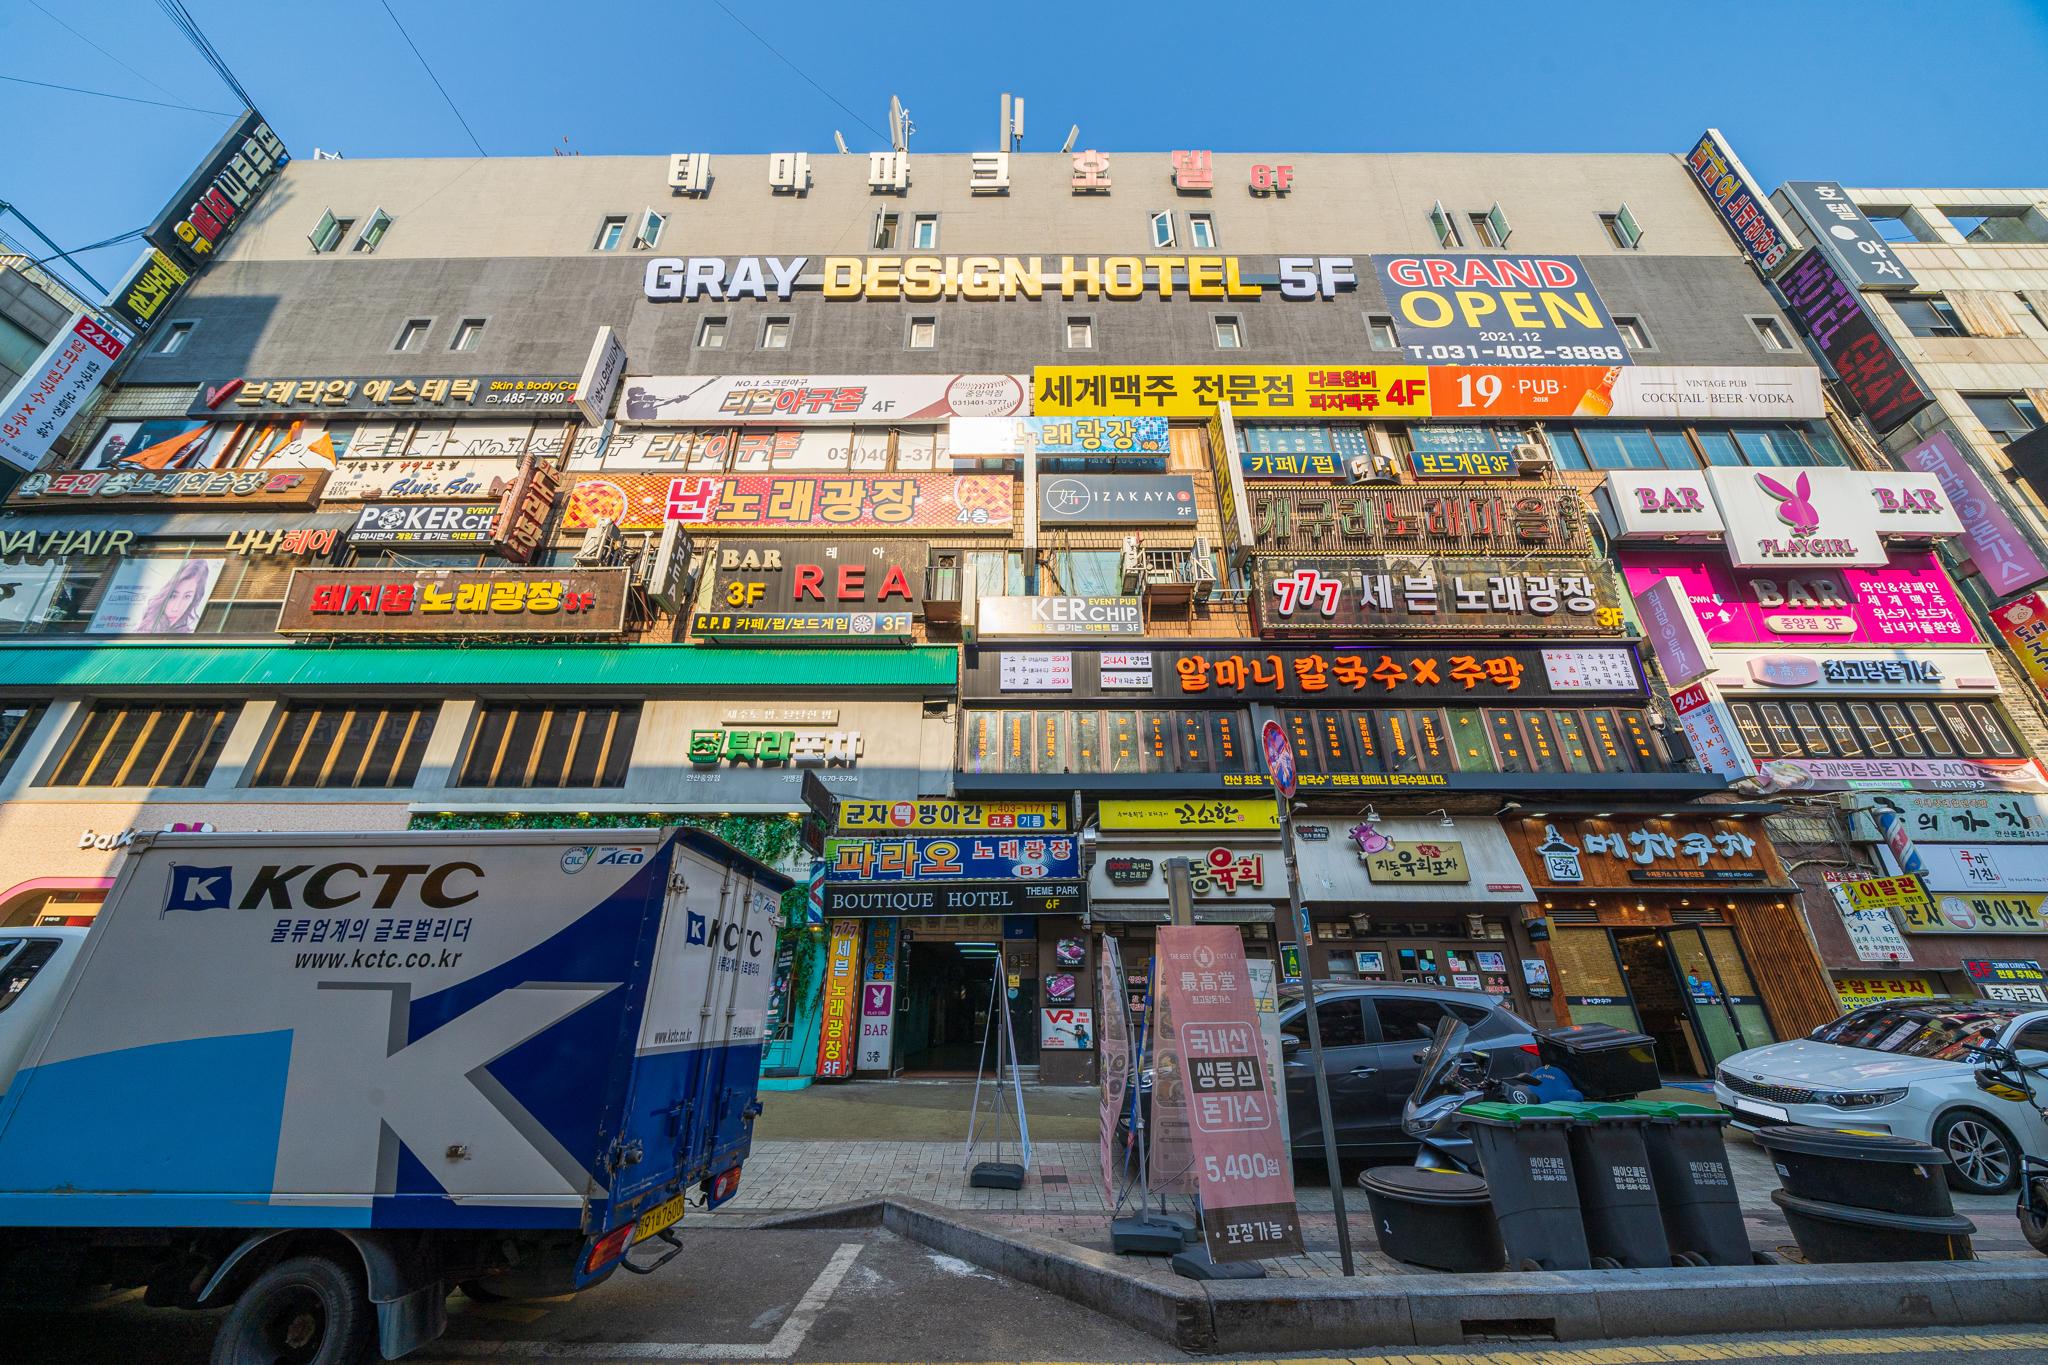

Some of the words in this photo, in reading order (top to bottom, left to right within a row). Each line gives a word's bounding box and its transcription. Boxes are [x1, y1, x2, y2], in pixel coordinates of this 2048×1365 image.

[1249, 163, 1296, 192] 6F
[1814, 186, 1860, 221] 호텔
[174, 220, 213, 256] 6F
[1765, 245, 1785, 267] B1
[1858, 241, 1903, 279] 야자
[644, 257, 809, 299] GRAY
[823, 256, 1043, 298] DESIGN
[1062, 256, 1263, 297] HOTEL
[1279, 256, 1357, 299] 5F
[1387, 258, 1578, 288] GRAND
[1400, 291, 1604, 329] OPEN
[135, 316, 150, 328] 3F
[81, 323, 118, 355] 24시
[1478, 332, 1542, 342] 2021.12
[1408, 345, 1624, 360] T.031-402-3888
[490, 381, 514, 390] Skin
[516, 382, 526, 390] &
[527, 382, 557, 392] Body
[735, 379, 761, 388] NO.1
[761, 378, 809, 388] 스크린야구
[1309, 370, 1377, 388] 다트완비
[234, 379, 357, 407] 브레라인
[363, 379, 482, 407] 에스테틱
[718, 386, 868, 416] 리얼야구존
[871, 400, 896, 413] 4F
[1040, 375, 1177, 407] 세계맥주
[1192, 375, 1295, 406] 전문점
[1386, 379, 1426, 406] 4F
[1456, 373, 1502, 409] 19
[1518, 380, 1560, 394] PUB
[1641, 392, 1704, 405] COCKTAIL
[1710, 393, 1744, 404] BEER
[1749, 393, 1795, 405] VODKA
[1309, 394, 1380, 411] 피자맥주
[1251, 456, 1335, 474] 카페/펍
[1491, 457, 1509, 473] 3F
[387, 477, 440, 497] Blues
[443, 477, 483, 496] Bar
[1093, 491, 1176, 502] IZAKAYA
[466, 507, 497, 515] EVENT
[1635, 487, 1705, 514] BAR
[1871, 487, 1944, 514] BAR
[955, 507, 990, 525] 4층
[1177, 507, 1192, 516] 2F
[40, 529, 134, 556] HAIR
[225, 529, 340, 556] 나나헤어
[1758, 539, 1859, 557] PLAYGIRL
[721, 549, 783, 571] BAR
[668, 547, 688, 602] REA
[793, 563, 913, 602] REA
[726, 581, 767, 609] 3F
[1273, 569, 1343, 617] 777
[1361, 574, 1438, 612] 세븐
[1456, 575, 1597, 614] 노래광장
[1597, 609, 1625, 627] 3F
[1750, 578, 1848, 609] BAR
[1859, 581, 1940, 594] 와인&샴페인
[309, 584, 416, 615] 돼지꿈
[420, 582, 565, 614] 노래광장
[564, 590, 597, 613] 3F
[1088, 598, 1116, 606] EVENT
[1119, 598, 1138, 606] PUB
[881, 616, 907, 632] 3F
[1089, 607, 1139, 622] CHIP
[1701, 611, 1715, 620] UP
[1780, 617, 1819, 631] 중앙점
[1826, 617, 1843, 631] 3F
[1126, 624, 1140, 632] 3F
[1880, 621, 1962, 634] 남녀커플환영
[1176, 654, 1286, 694] 알마니
[1293, 654, 1408, 693] 칼국수
[1448, 654, 1525, 692] 주막
[1826, 659, 1945, 682] 최고당돈가스
[1676, 693, 1704, 711] 24시
[1223, 774, 1243, 786] 안산
[1245, 774, 1262, 786] 최초
[1332, 774, 1359, 786] 전문점
[1361, 774, 1389, 786] 알마니
[987, 803, 1047, 813] T.403-1171
[1174, 801, 1239, 825] 꼬소한
[991, 815, 1013, 827] 고추
[1020, 815, 1043, 827] 기름
[596, 849, 645, 865] AEO
[833, 840, 963, 879] 파라오
[972, 839, 1072, 861] 노래광장
[1019, 865, 1043, 876] B1
[1969, 868, 1996, 882] 키친
[237, 861, 486, 910] KCTC
[1859, 878, 1918, 898] 이발관
[832, 892, 934, 910] BOUTIQUE
[948, 891, 1014, 907] HOTEL
[1025, 886, 1055, 896] THEME
[1056, 886, 1079, 896] PARK
[1045, 899, 1060, 910] 6F
[270, 918, 367, 944] 물류업계의
[373, 917, 472, 944] 글로벌리더
[833, 921, 858, 939] 777
[295, 949, 463, 970] www.kctc.co.kr
[834, 940, 851, 977] 세븐
[1968, 961, 1993, 978] 5F
[1180, 971, 1237, 993] 最高堂
[825, 979, 847, 1060] 노래광장
[1045, 1009, 1075, 1024] VR
[864, 1024, 888, 1036] BAR
[1190, 1028, 1249, 1055] 국내산
[866, 1051, 881, 1063] 3층
[823, 1061, 841, 1075] 3F
[1196, 1060, 1257, 1089] 생등심
[1202, 1095, 1264, 1124] 돈가스
[1226, 1221, 1283, 1245] 포장가능
